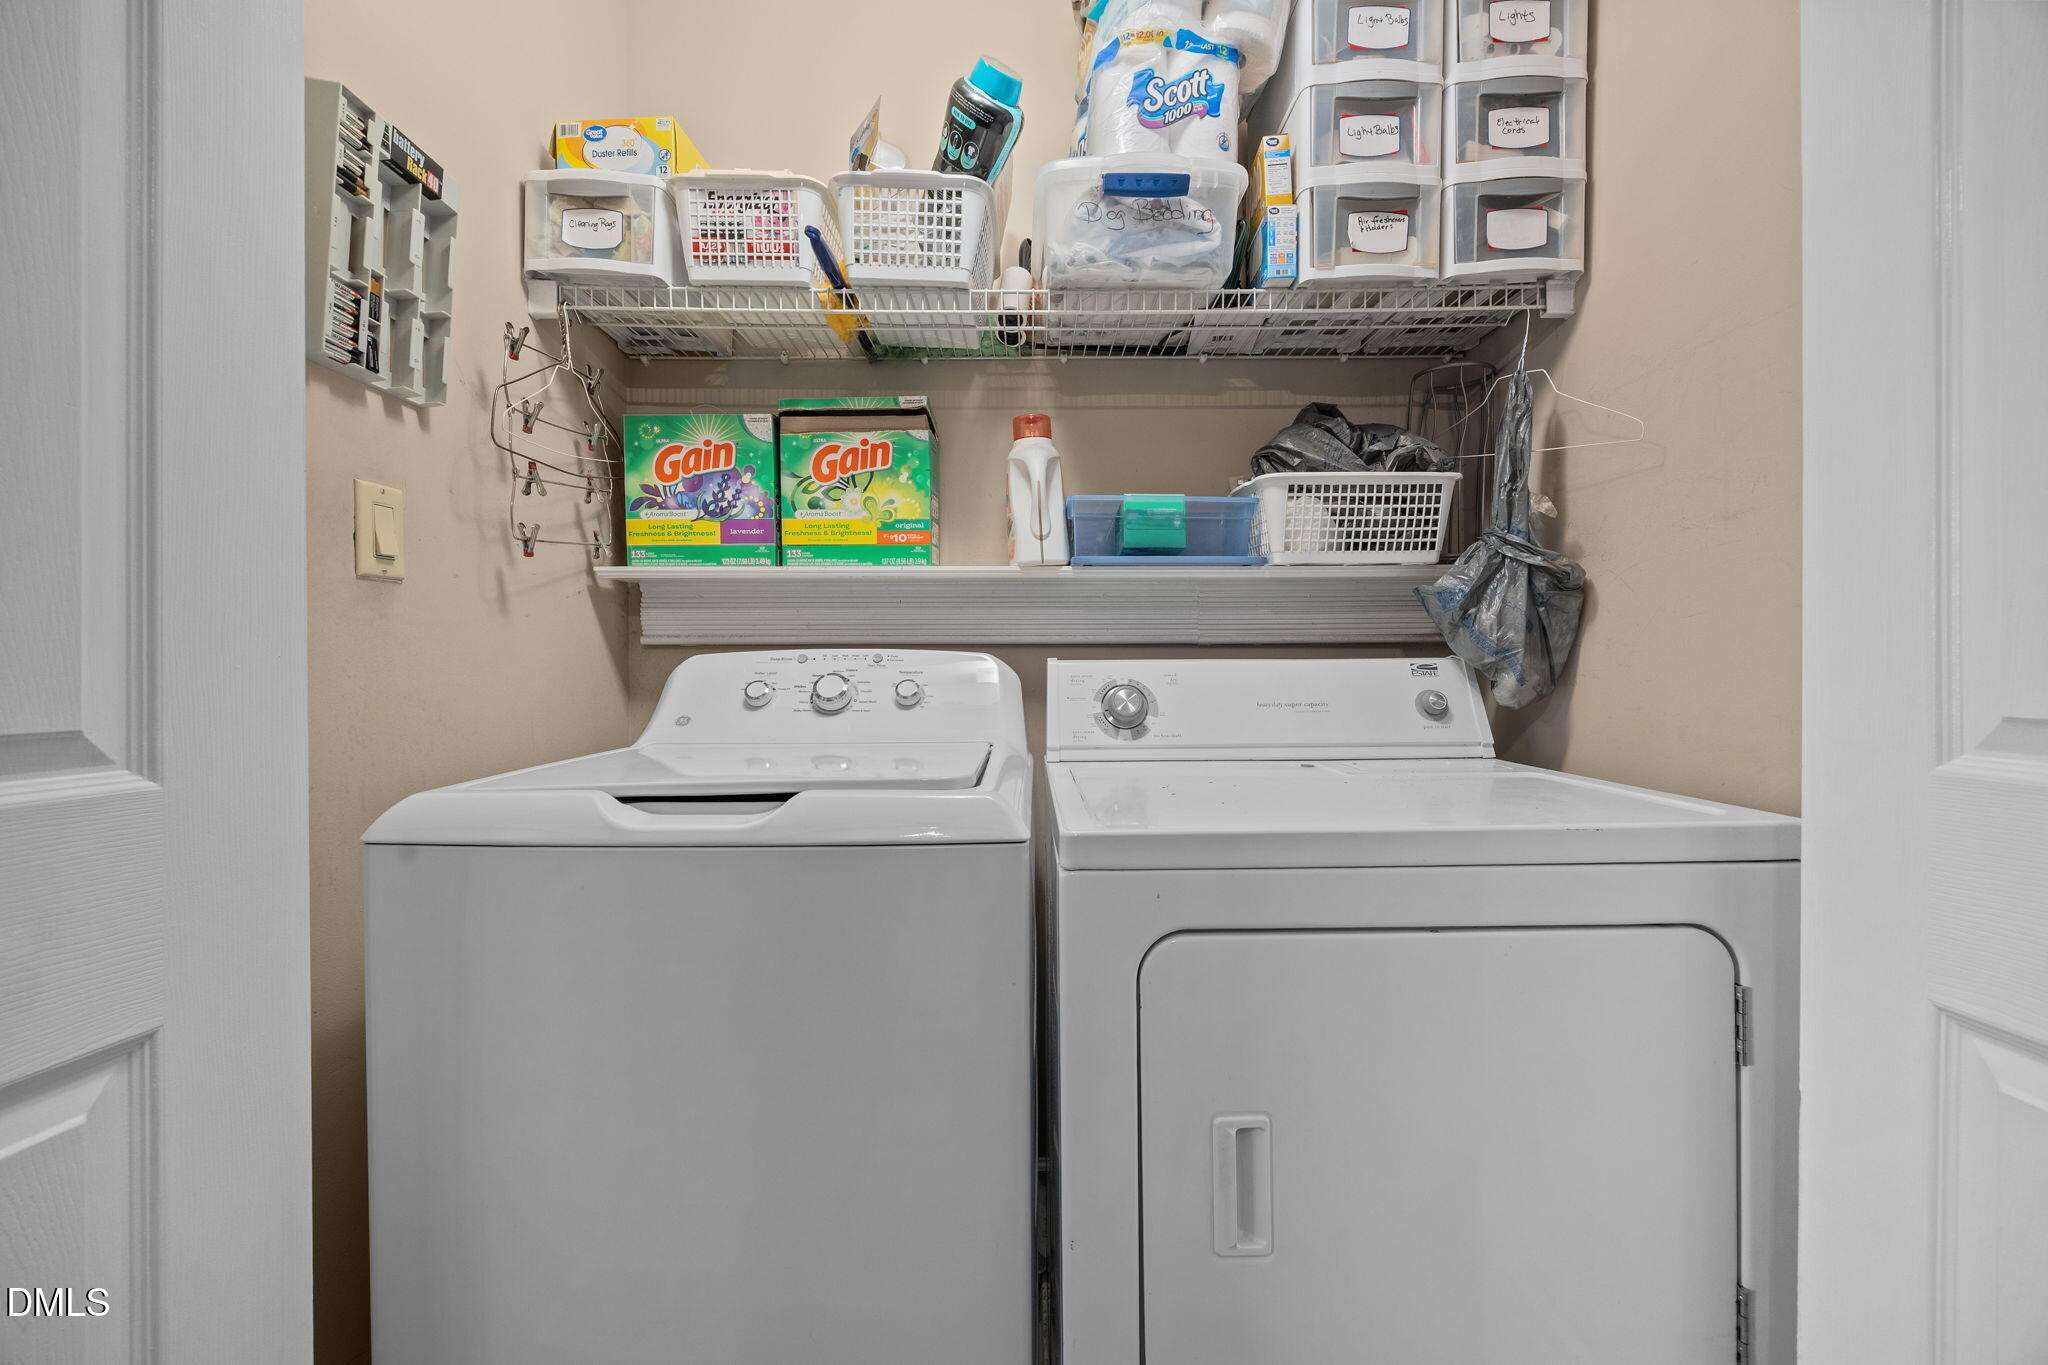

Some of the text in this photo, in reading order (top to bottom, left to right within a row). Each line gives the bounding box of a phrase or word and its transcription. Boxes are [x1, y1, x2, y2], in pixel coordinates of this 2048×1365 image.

[1498, 9, 1536, 26] Lights
[1143, 68, 1210, 113] Scott
[1163, 102, 1194, 124] 1000
[392, 128, 426, 168] battery
[591, 148, 638, 158] Duster Refills
[406, 155, 440, 194] Rack 40
[659, 165, 668, 174] 12
[1077, 197, 1214, 236] Dog Bedding
[1357, 216, 1369, 226] Air
[568, 218, 599, 232] Cleaning
[653, 438, 735, 484] Gain
[811, 438, 892, 484] Gain
[667, 523, 694, 531] Lasting
[895, 522, 924, 530] original
[674, 530, 716, 538] Brightness!
[729, 528, 765, 536] lavender
[831, 530, 872, 538] Brightness!
[631, 550, 646, 559] 133
[786, 549, 802, 558] 133
[1303, 701, 1329, 709] capacity
